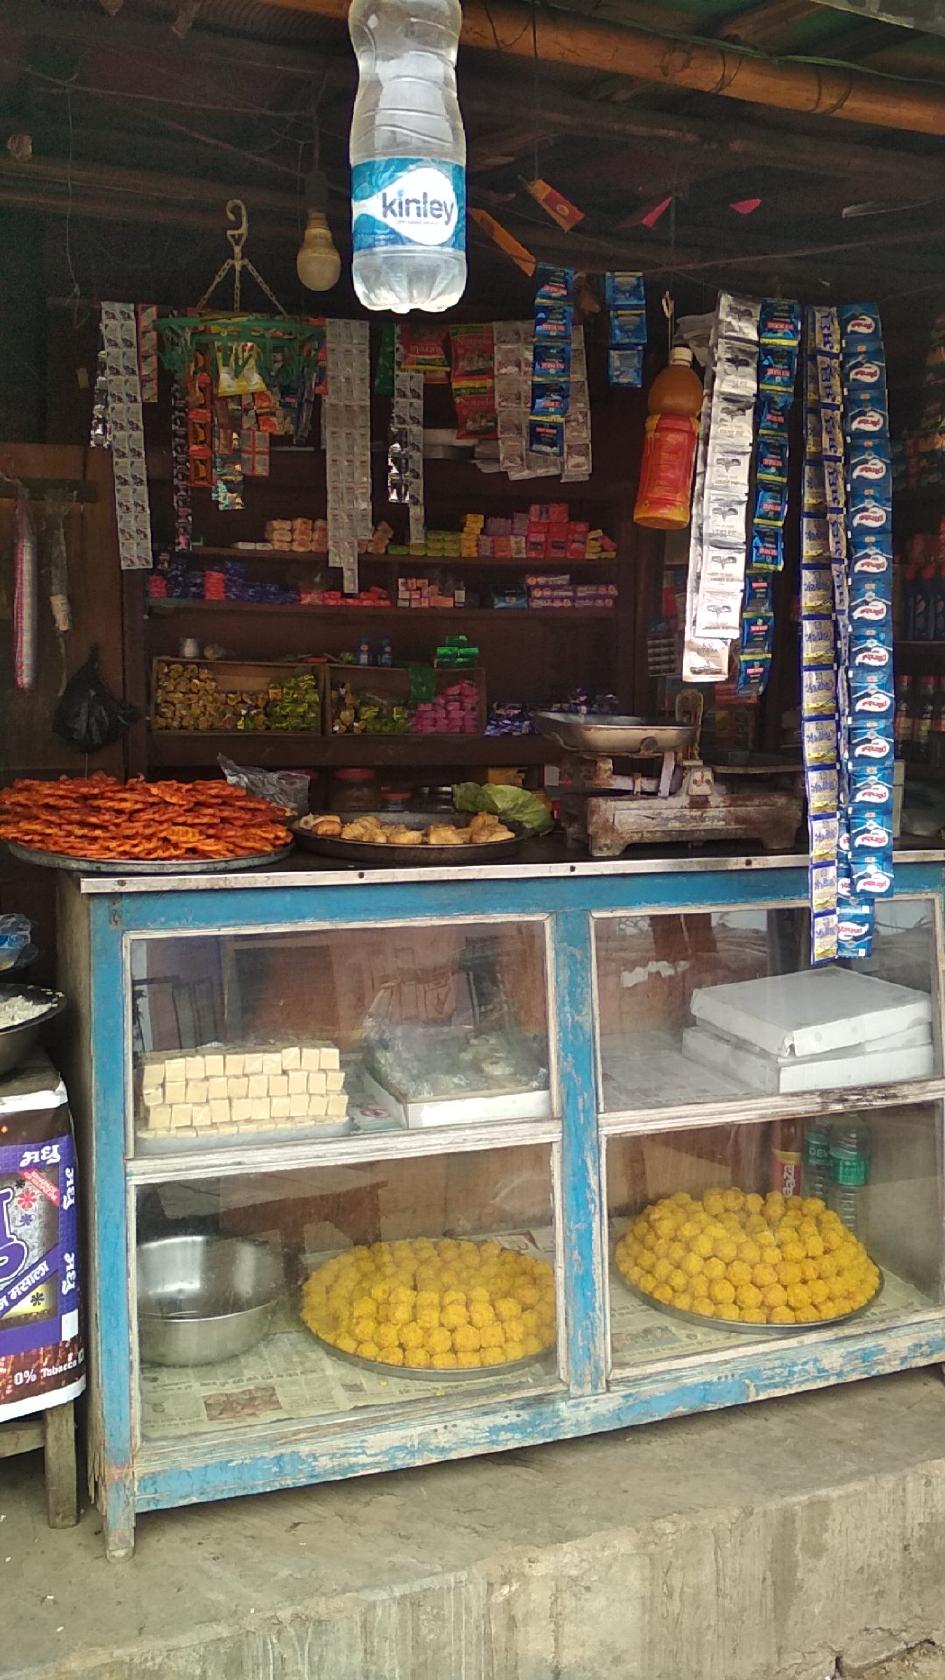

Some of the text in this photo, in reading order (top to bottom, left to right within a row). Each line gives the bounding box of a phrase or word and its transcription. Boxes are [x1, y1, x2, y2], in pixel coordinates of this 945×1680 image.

[382, 189, 455, 226] kinley
[7, 1260, 49, 1300] मसाला
[14, 1368, 37, 1386] 0%
[40, 1359, 77, 1377] Tobacco
